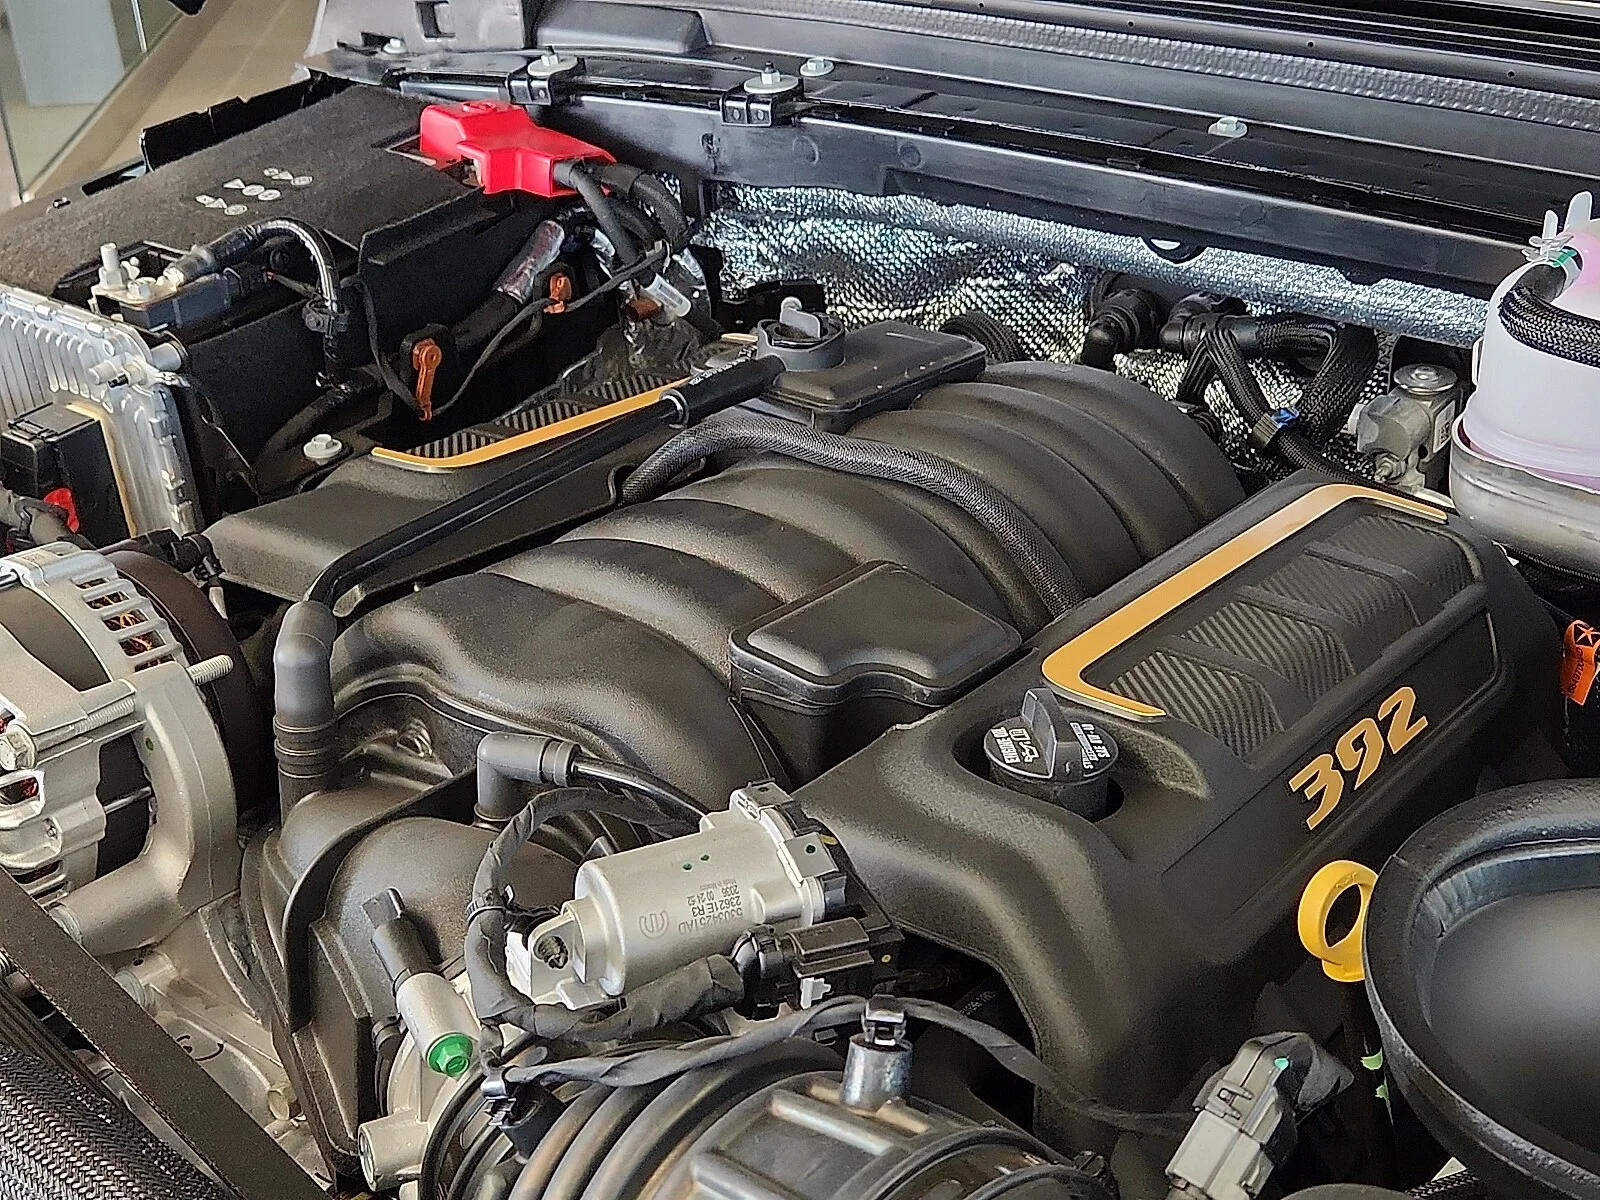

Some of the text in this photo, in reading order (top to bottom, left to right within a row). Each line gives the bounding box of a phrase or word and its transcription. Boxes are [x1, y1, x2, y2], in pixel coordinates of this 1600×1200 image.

[991, 727, 1021, 763] ENGINE OIL
[1288, 686, 1429, 831] 392
[691, 895, 742, 917] 23621E R3
